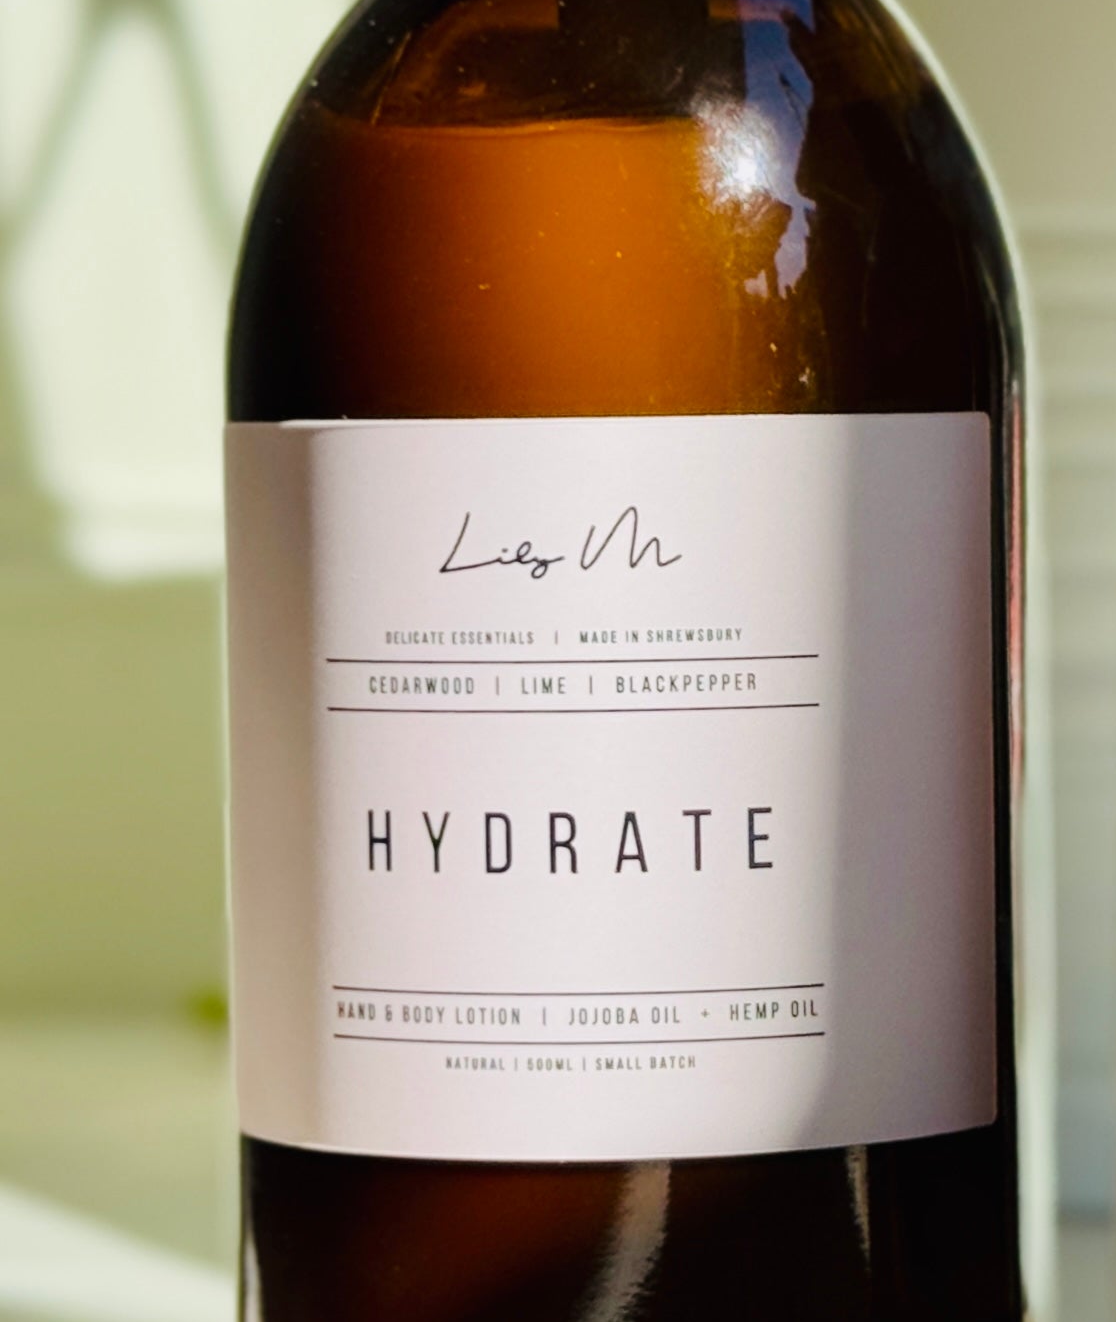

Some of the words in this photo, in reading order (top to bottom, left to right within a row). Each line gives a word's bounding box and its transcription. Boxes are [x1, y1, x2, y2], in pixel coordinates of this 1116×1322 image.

[438, 511, 566, 581] Lily
[385, 630, 445, 646] DELICATE
[451, 630, 535, 646] ESSENTIALS
[578, 629, 618, 645] MADE
[624, 629, 640, 644] IN
[646, 627, 743, 644] SHREWSBURY
[368, 675, 475, 696] CEDARWOOD
[520, 676, 567, 696] LIME
[615, 672, 757, 695] BLACKPEPPER
[367, 806, 774, 875] HYDRATE
[336, 1001, 377, 1022] HAND
[384, 1003, 393, 1023] &
[401, 1004, 446, 1025] BODY
[454, 1006, 521, 1026] LOTION
[568, 1006, 640, 1027] JOJOBA
[650, 1005, 681, 1025] OIL
[729, 1001, 780, 1022] HEMP
[789, 998, 819, 1019] OIL
[445, 1056, 506, 1071] NATURAL
[526, 1057, 573, 1072] 500ML
[594, 1056, 643, 1072] SMALL
[649, 1055, 696, 1071] BATCH
